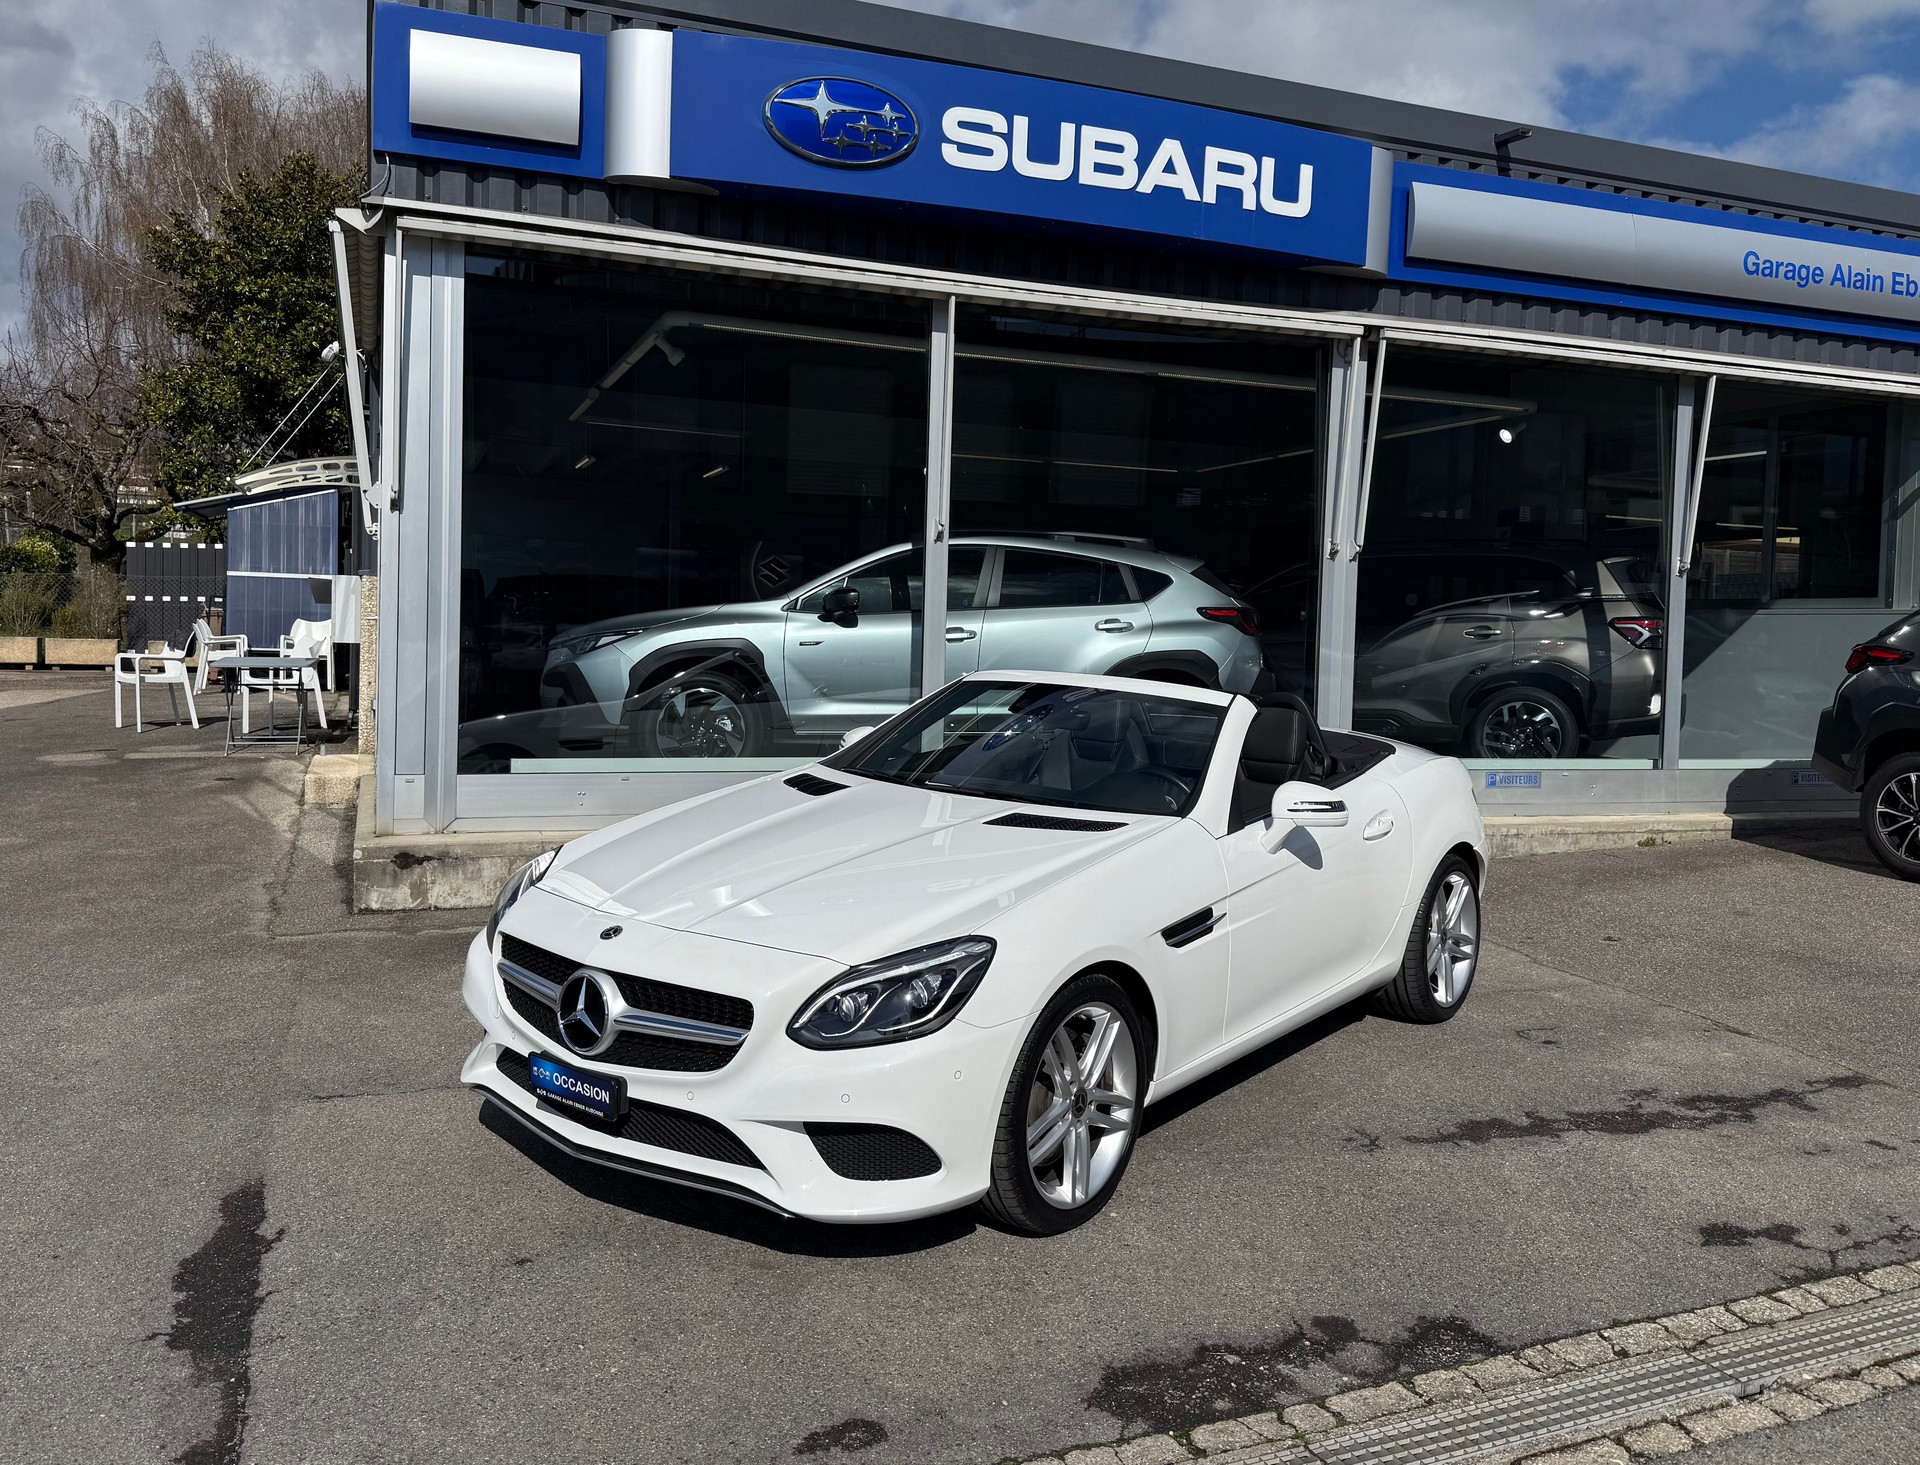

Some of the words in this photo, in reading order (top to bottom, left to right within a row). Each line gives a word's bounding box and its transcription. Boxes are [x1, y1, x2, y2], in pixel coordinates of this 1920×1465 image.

[941, 106, 1314, 218] SUBARU
[1743, 250, 1824, 288] Garage
[1829, 263, 1884, 293] Alain
[1891, 271, 1920, 298] Eb
[1500, 775, 1538, 785] VISITEURS
[552, 1072, 610, 1104] OCCASION
